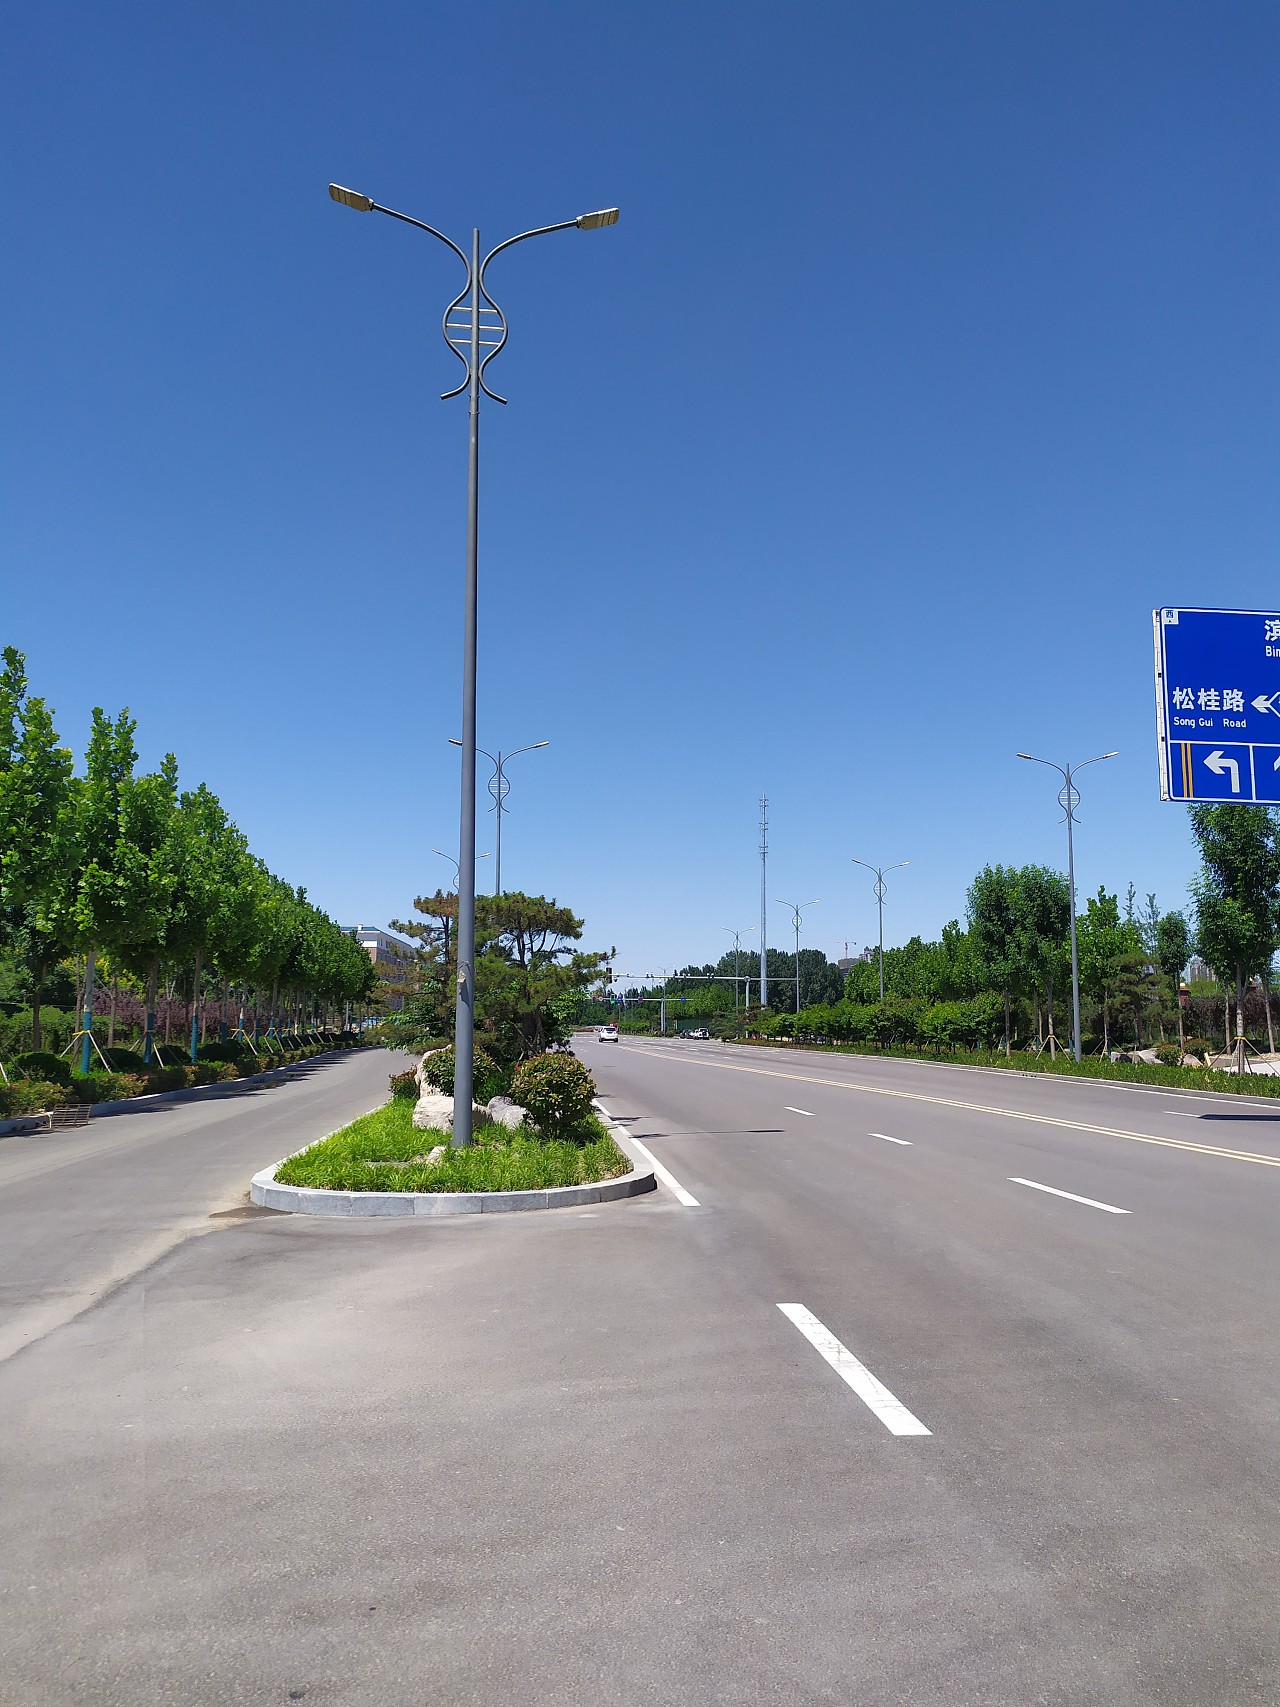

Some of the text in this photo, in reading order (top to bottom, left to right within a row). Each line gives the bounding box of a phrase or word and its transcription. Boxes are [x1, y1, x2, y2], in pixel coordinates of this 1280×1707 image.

[1172, 687, 1245, 712] 松桂路
[1173, 716, 1247, 729] Song Gui Road
